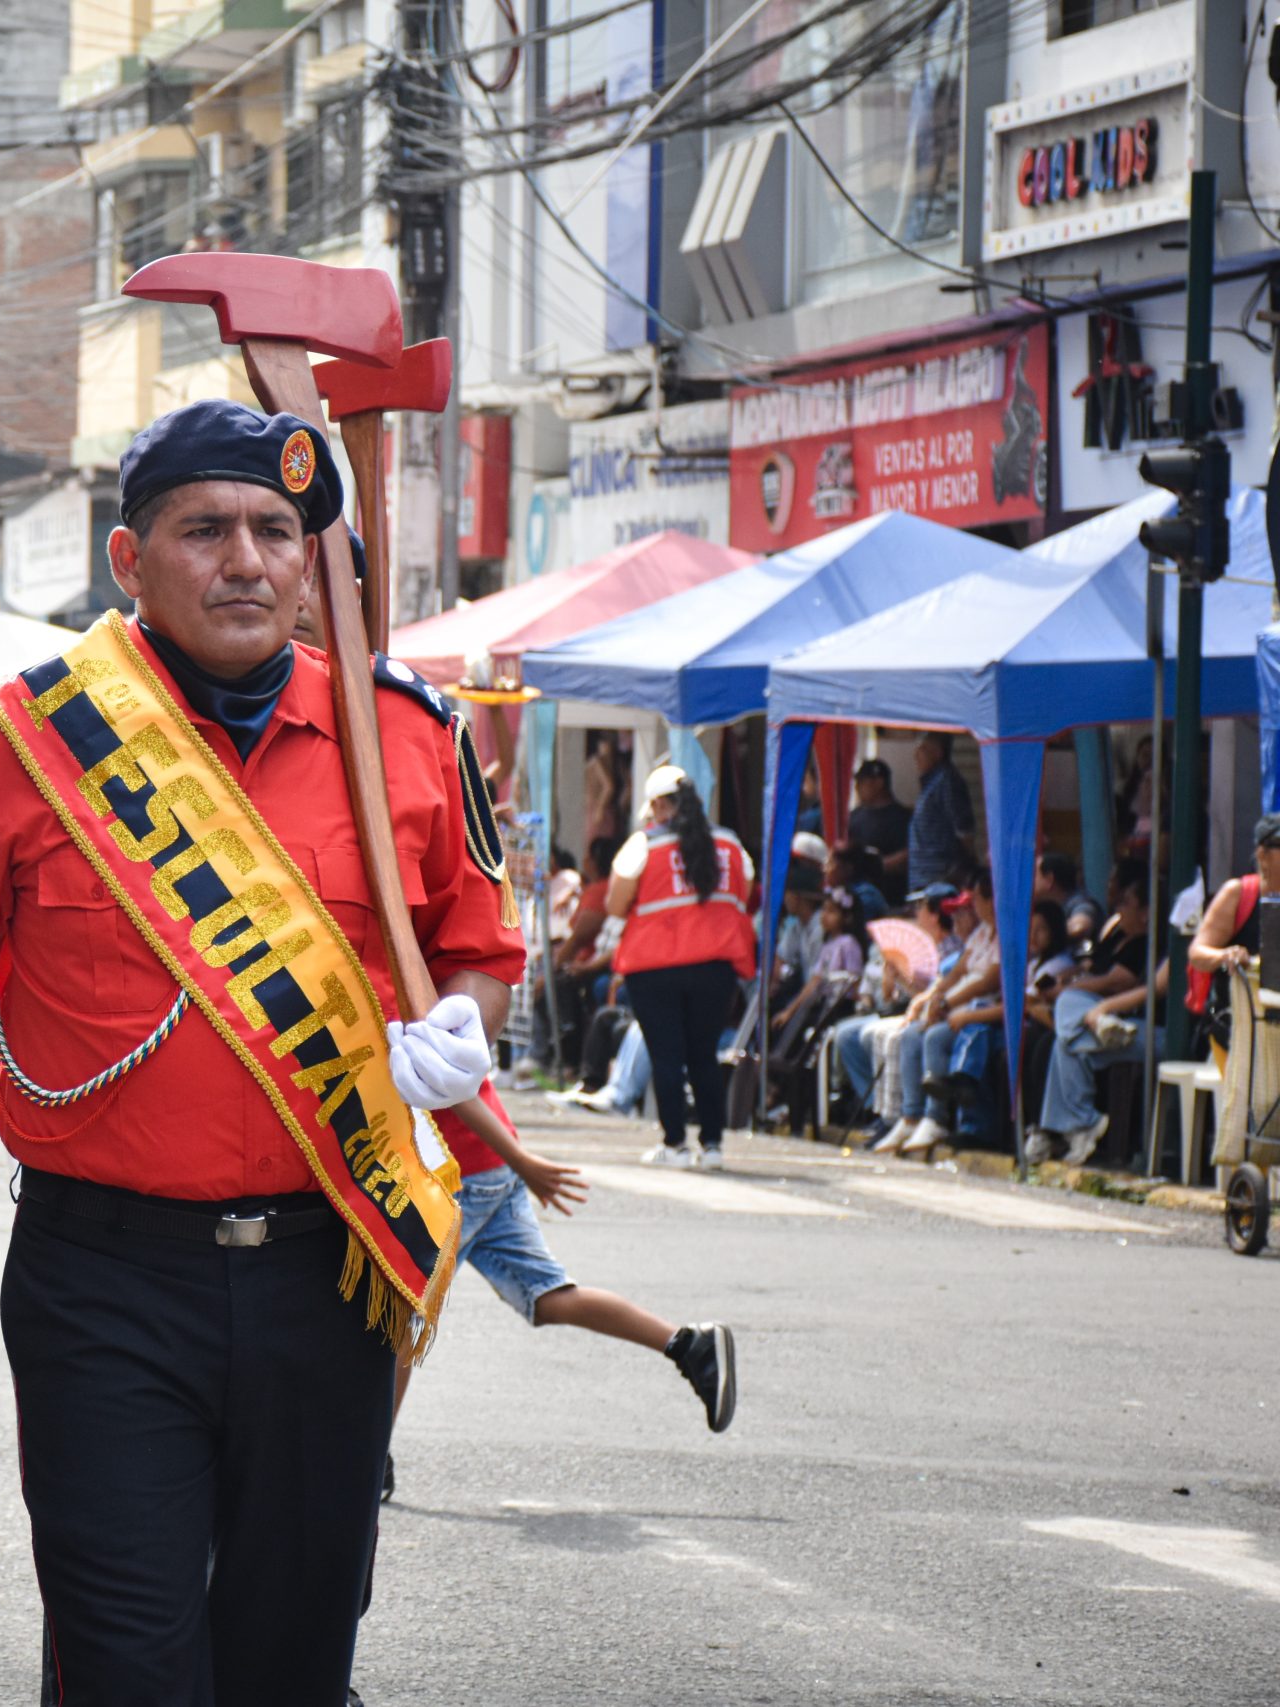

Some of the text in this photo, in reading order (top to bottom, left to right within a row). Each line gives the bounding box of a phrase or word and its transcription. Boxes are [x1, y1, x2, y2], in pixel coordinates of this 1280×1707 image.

[1017, 117, 1153, 209] COOL KIDS
[851, 364, 907, 429] MOTO
[913, 344, 996, 417] MILAGRO
[871, 479, 917, 514] MAYOR
[919, 479, 929, 511] Y
[932, 469, 979, 510] MENOR
[875, 429, 974, 476] VENTAS AL POR
[75, 721, 375, 1129] ESCOLTA
